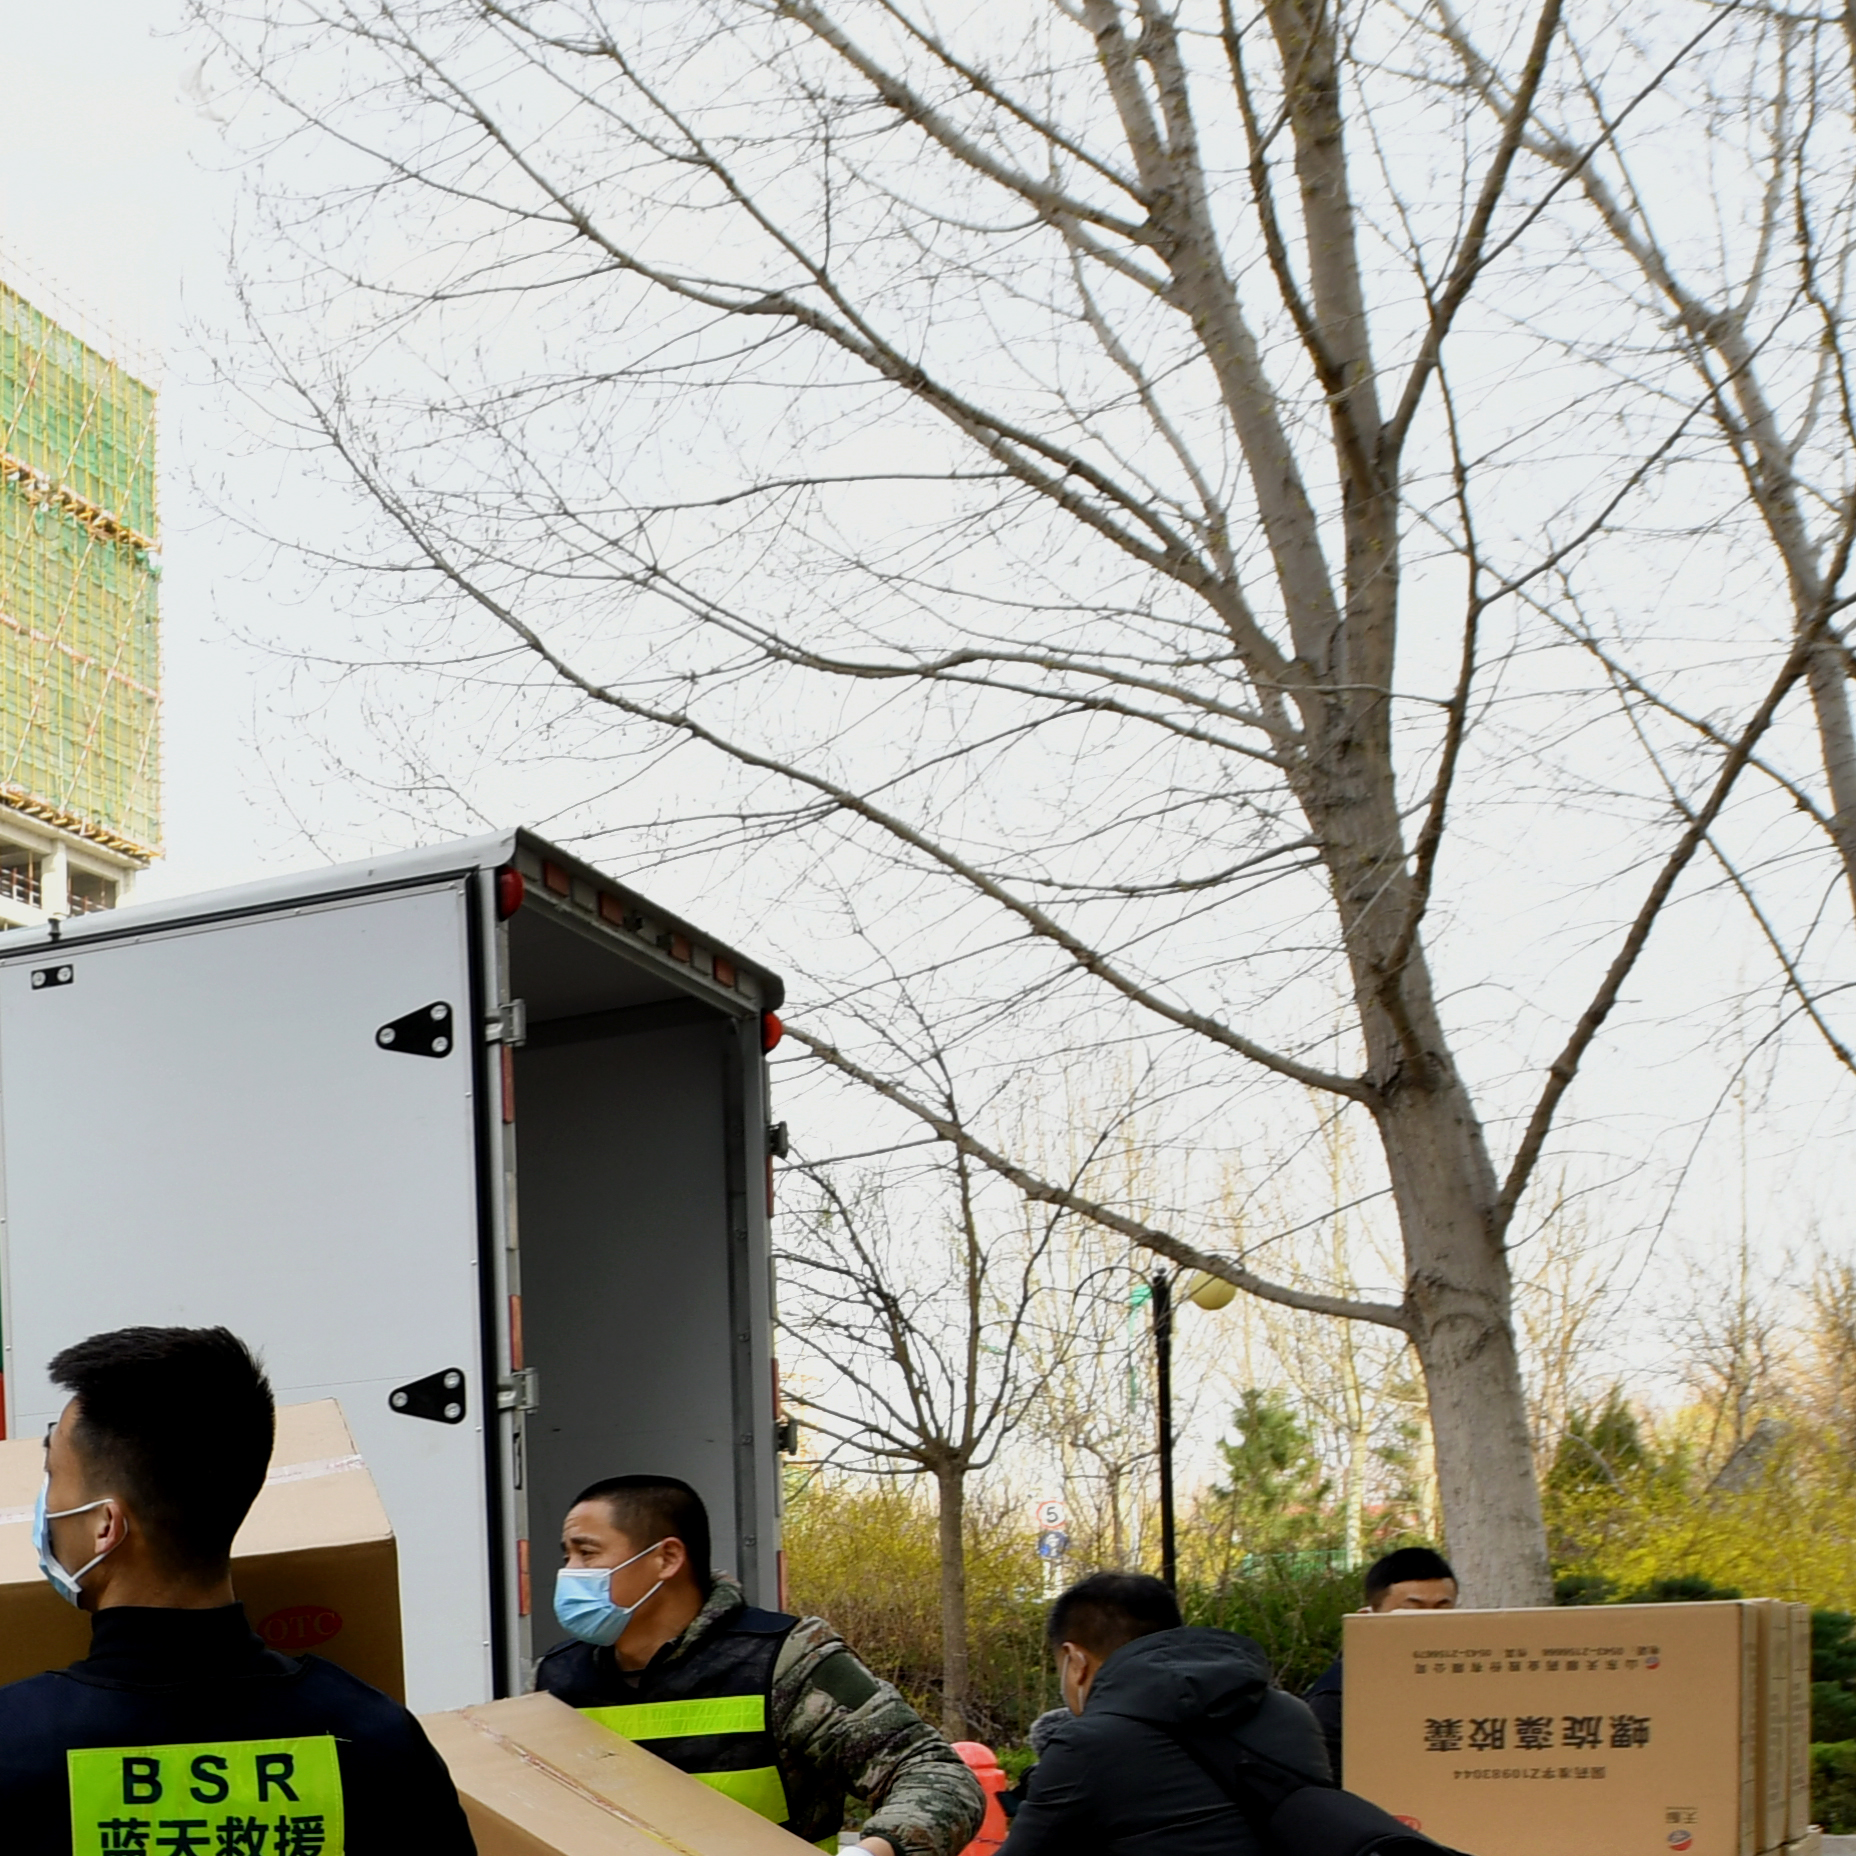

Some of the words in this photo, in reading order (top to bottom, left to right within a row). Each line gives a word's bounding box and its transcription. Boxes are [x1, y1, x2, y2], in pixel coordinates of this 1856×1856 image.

[1046, 1506, 1059, 1523] 5
[263, 1611, 337, 1642] OTC
[1422, 1714, 1652, 1753] 螺旋藻胶囊
